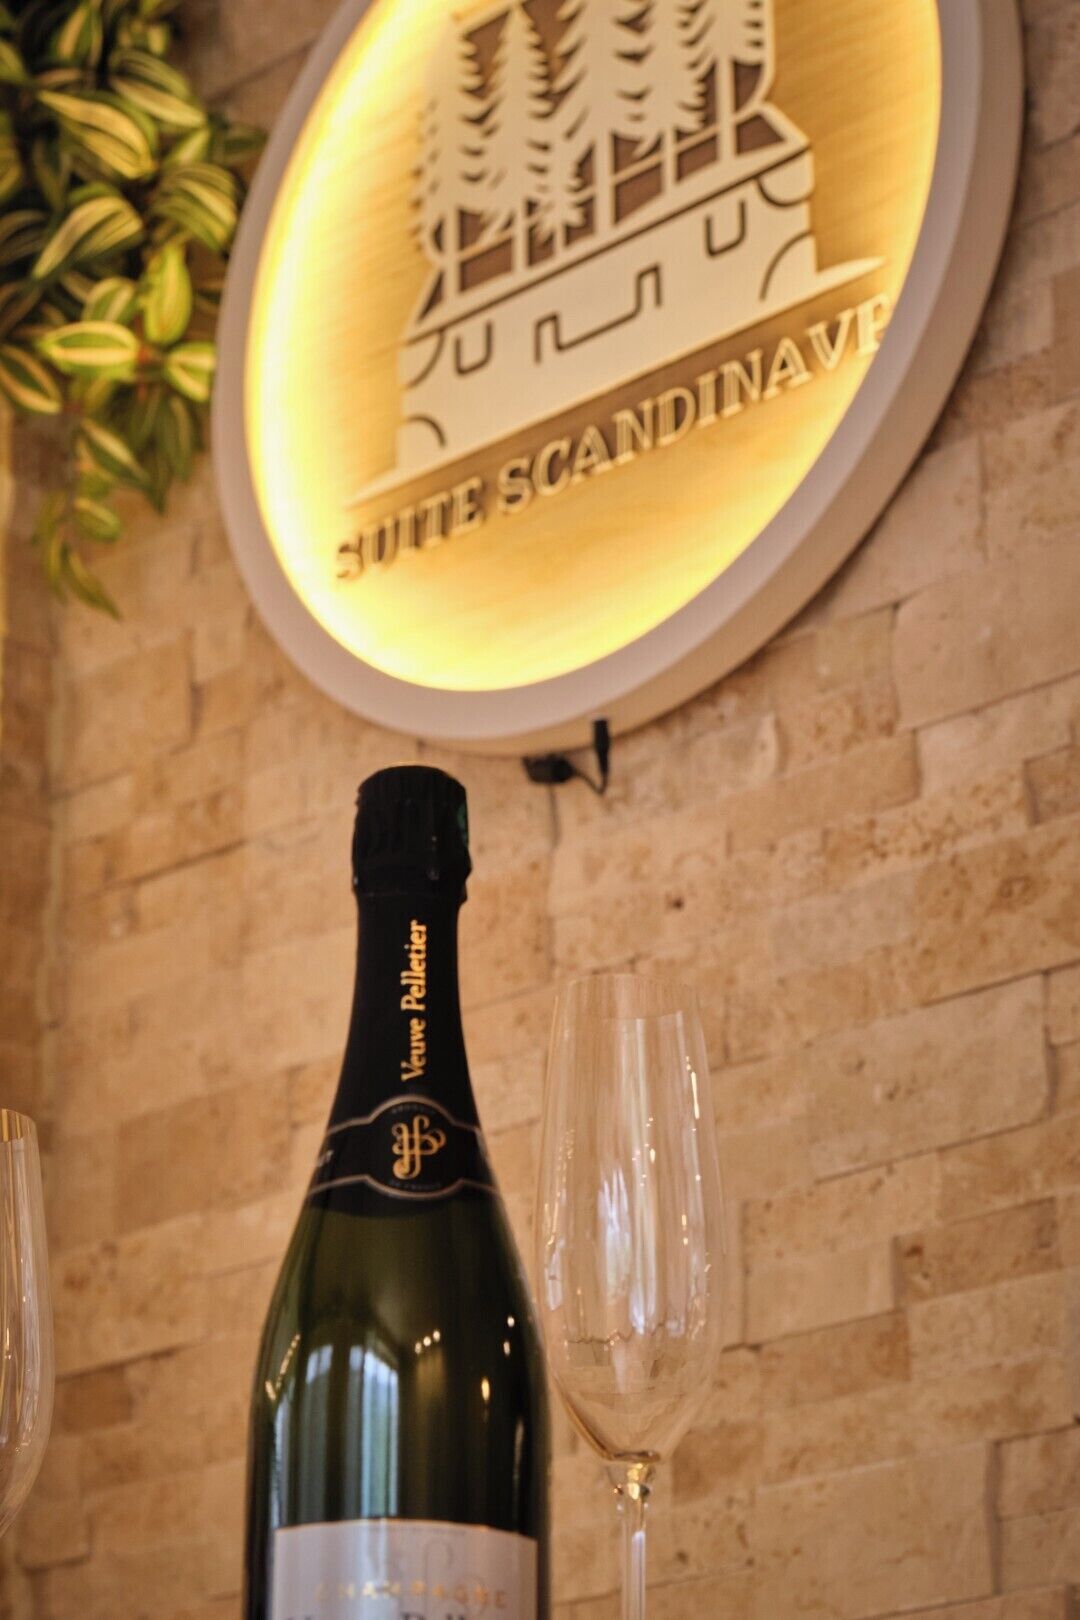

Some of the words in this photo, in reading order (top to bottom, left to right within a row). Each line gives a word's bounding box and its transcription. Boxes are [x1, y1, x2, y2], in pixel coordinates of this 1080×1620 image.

[336, 476, 484, 580] SUITE
[401, 919, 428, 1012] Pelletier
[401, 1018, 427, 1081] Veuve
